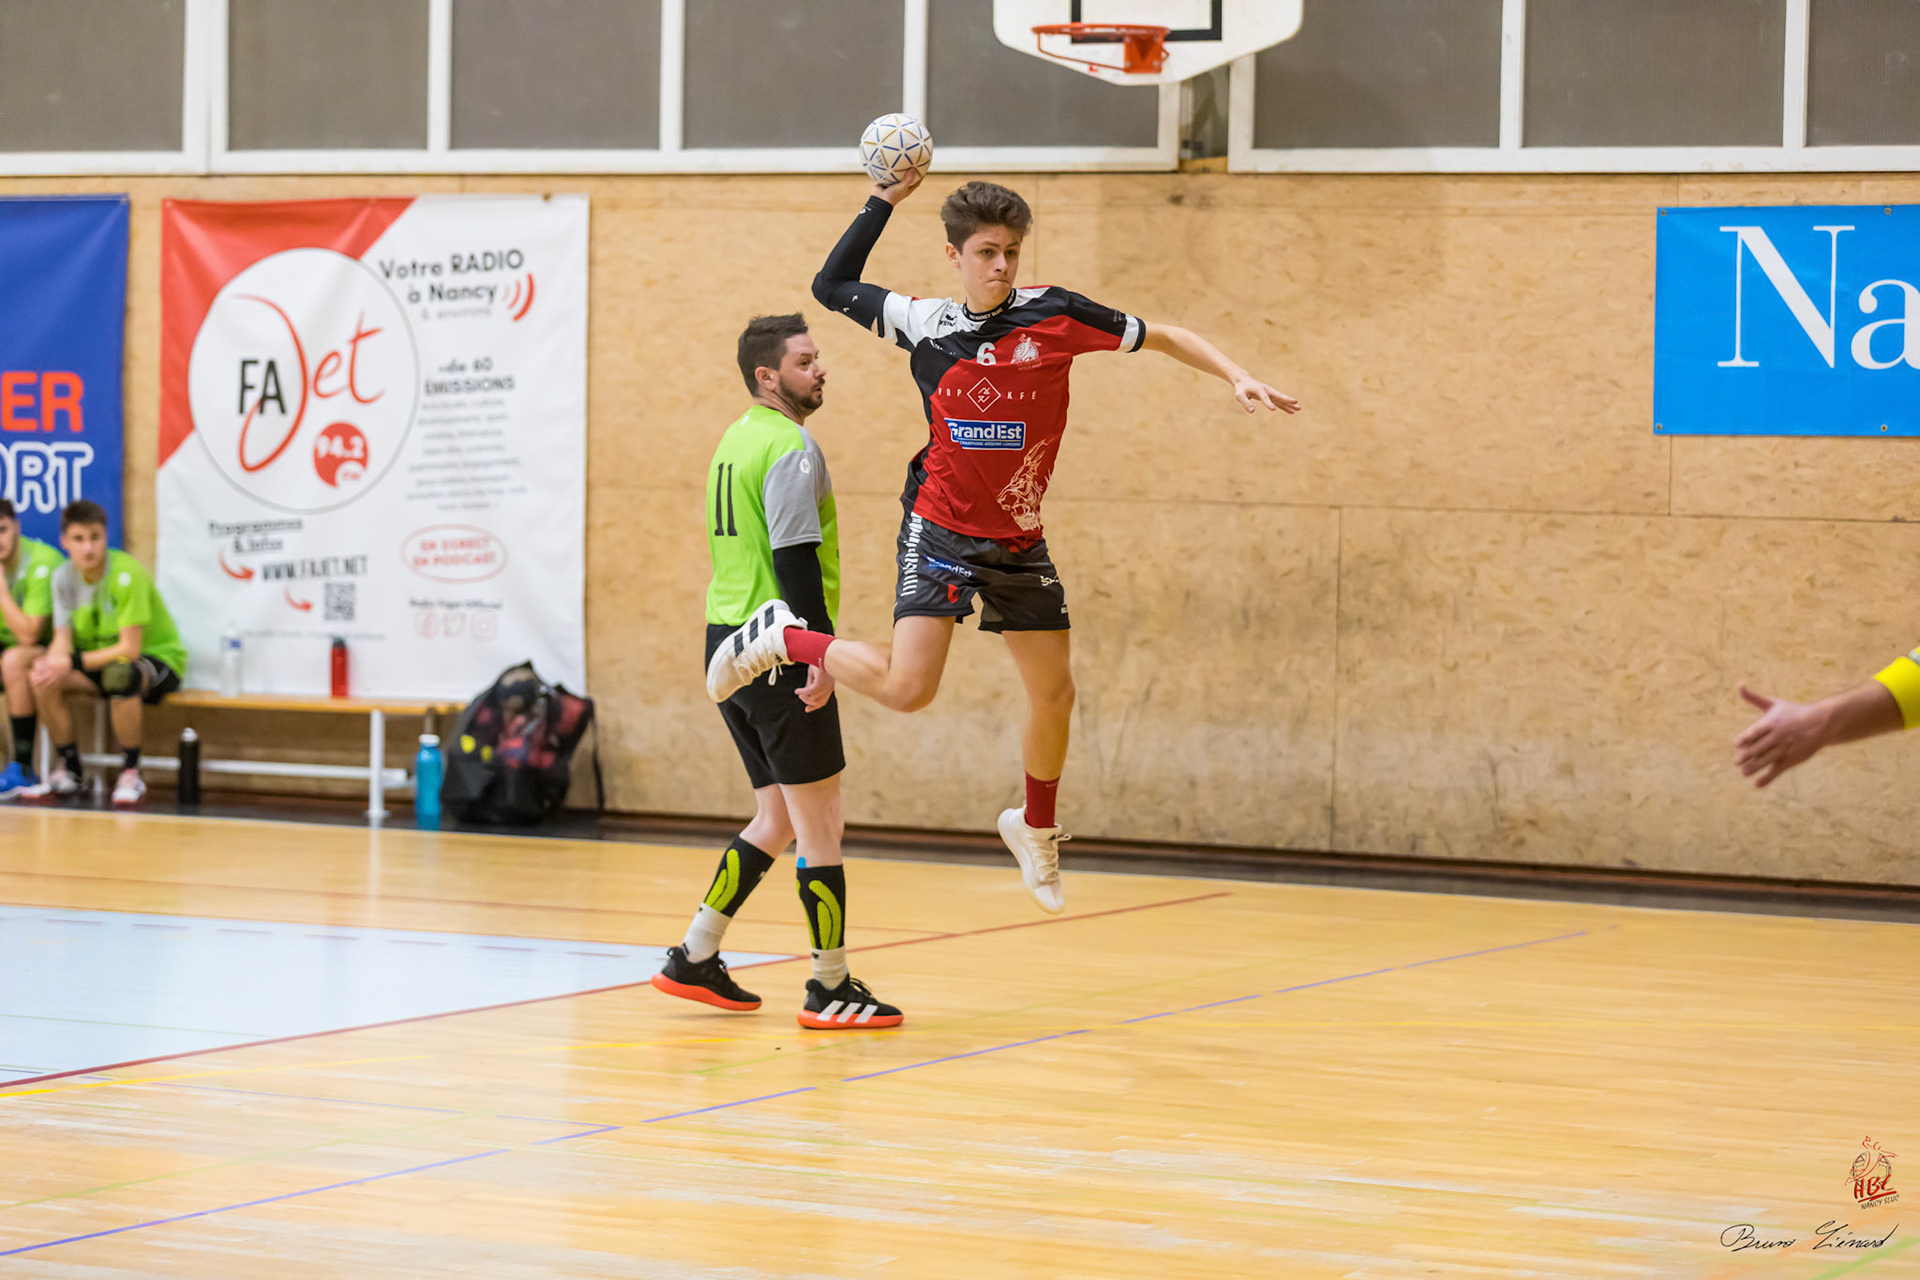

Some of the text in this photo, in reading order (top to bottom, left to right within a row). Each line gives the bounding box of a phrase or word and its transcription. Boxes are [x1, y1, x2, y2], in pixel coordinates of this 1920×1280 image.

[378, 249, 524, 279] Votre RADIO
[430, 283, 498, 306] Nancy
[1717, 225, 1920, 370] Na
[976, 342, 997, 366] 6
[1, 371, 84, 432] ER
[714, 463, 738, 536] 11
